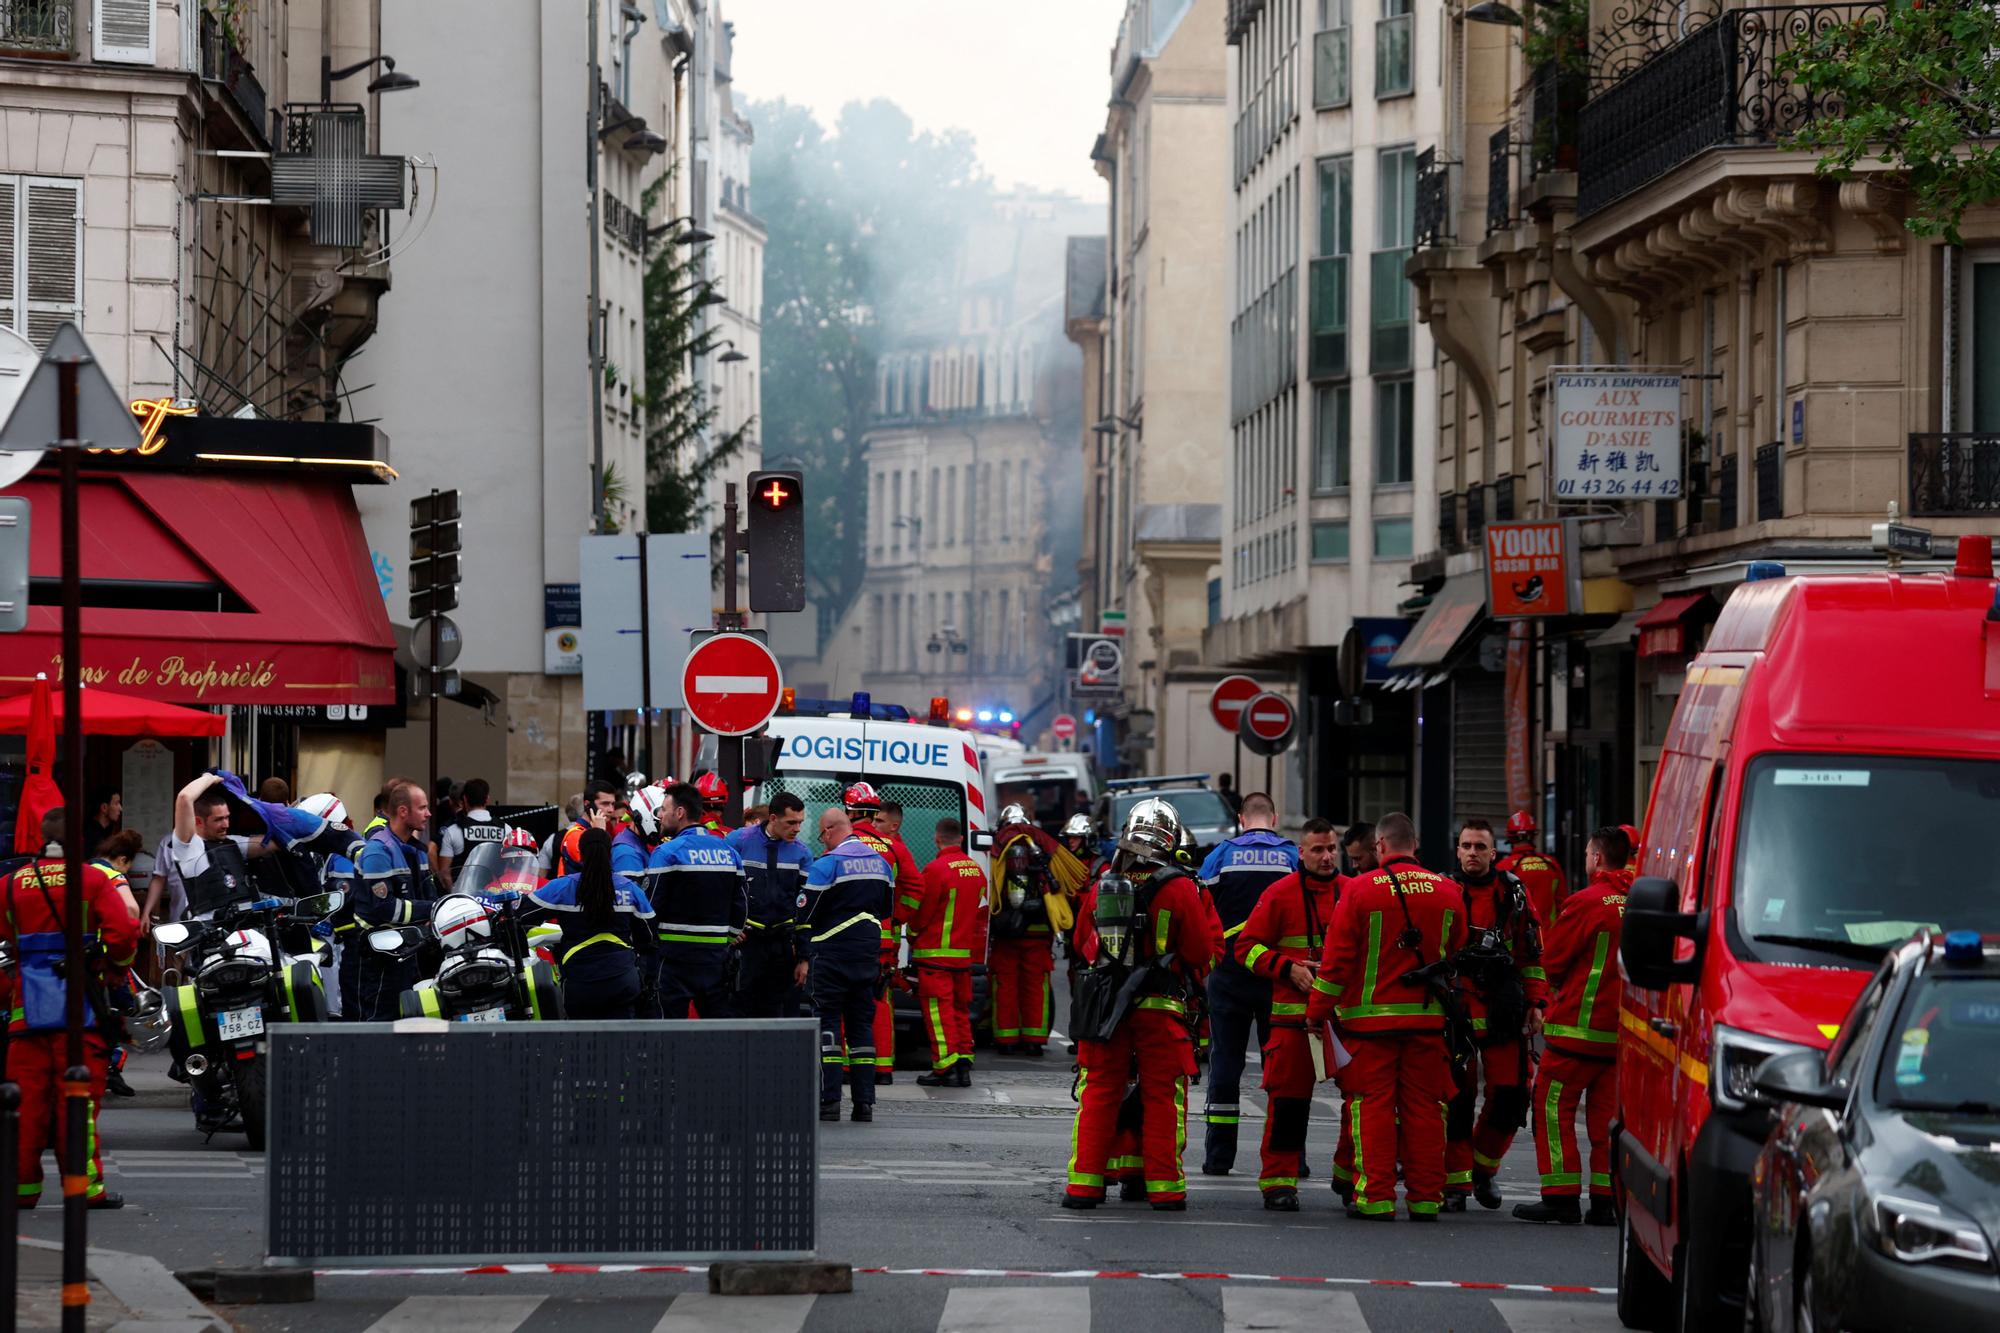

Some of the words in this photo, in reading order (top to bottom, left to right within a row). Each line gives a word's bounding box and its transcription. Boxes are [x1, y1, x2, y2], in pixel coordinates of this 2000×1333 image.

[1560, 377, 1597, 388] PLATS
[1599, 378, 1609, 388] A
[1612, 378, 1680, 388] EMPORTER
[1595, 390, 1642, 406] AUX
[1561, 411, 1676, 426] GOURMETS
[1585, 431, 1652, 447] D'ASIE
[1558, 479, 1576, 494] 01
[1582, 479, 1602, 494] 43
[1606, 479, 1626, 494] 26
[1632, 479, 1653, 494] 44
[1658, 479, 1680, 494] 42
[1490, 528, 1560, 557] YOOKI
[1494, 558, 1530, 572] SUSHI
[1534, 557, 1559, 571] BAR
[118, 656, 153, 685] de
[274, 705, 283, 716] 43
[284, 705, 294, 716] 54
[295, 706, 305, 716] 87
[307, 706, 316, 716] 75
[780, 735, 949, 767] OGISTIQUE
[467, 827, 502, 839] POLICE
[688, 849, 734, 865] POLICE
[1232, 850, 1287, 865] POLICE
[843, 858, 885, 874] POLICE
[959, 868, 980, 877] PARIS
[22, 874, 67, 889] PARIS
[1390, 881, 1434, 896] PARIS
[1602, 894, 1627, 905] SAPEUR
[230, 1012, 243, 1022] FK
[222, 1019, 261, 1034] 758-CZ
